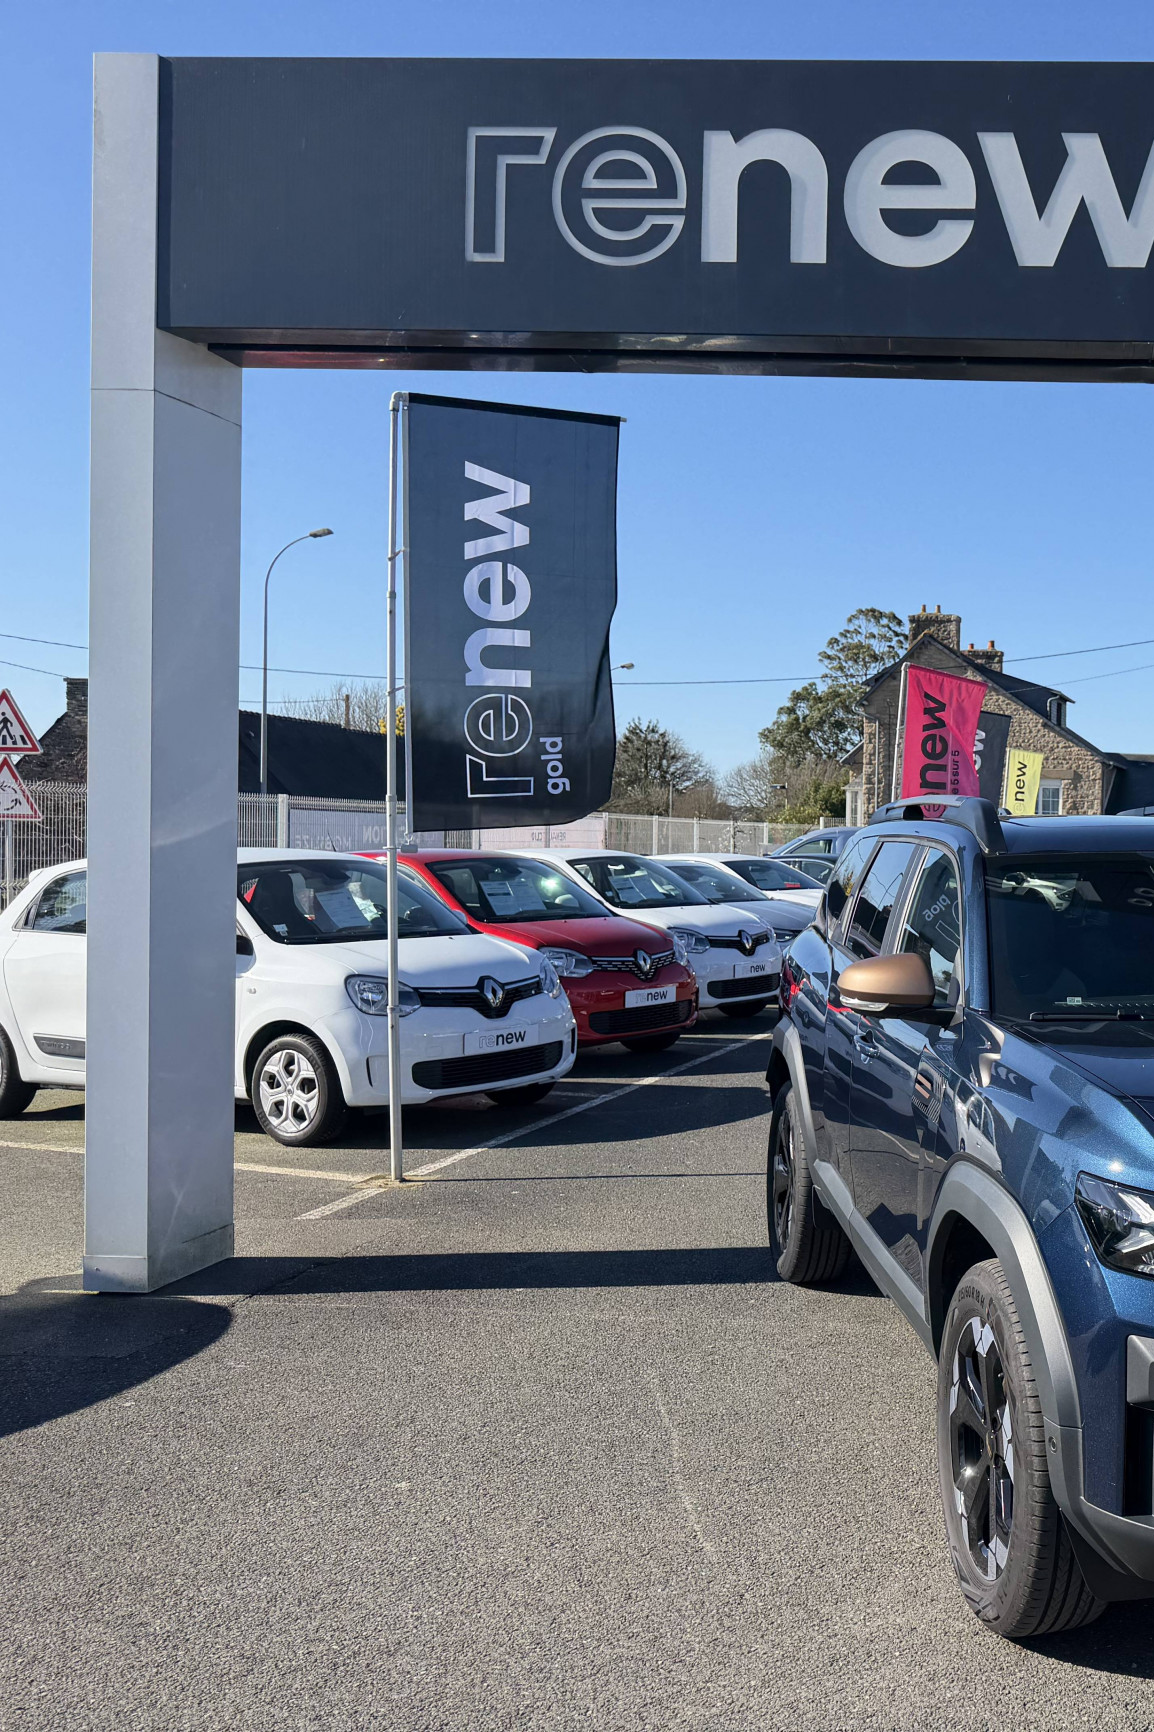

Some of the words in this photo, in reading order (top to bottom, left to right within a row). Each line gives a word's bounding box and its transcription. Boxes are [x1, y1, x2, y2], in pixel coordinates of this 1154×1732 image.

[463, 460, 534, 798] renew
[540, 736, 570, 795] gold
[479, 1030, 526, 1048] renew
